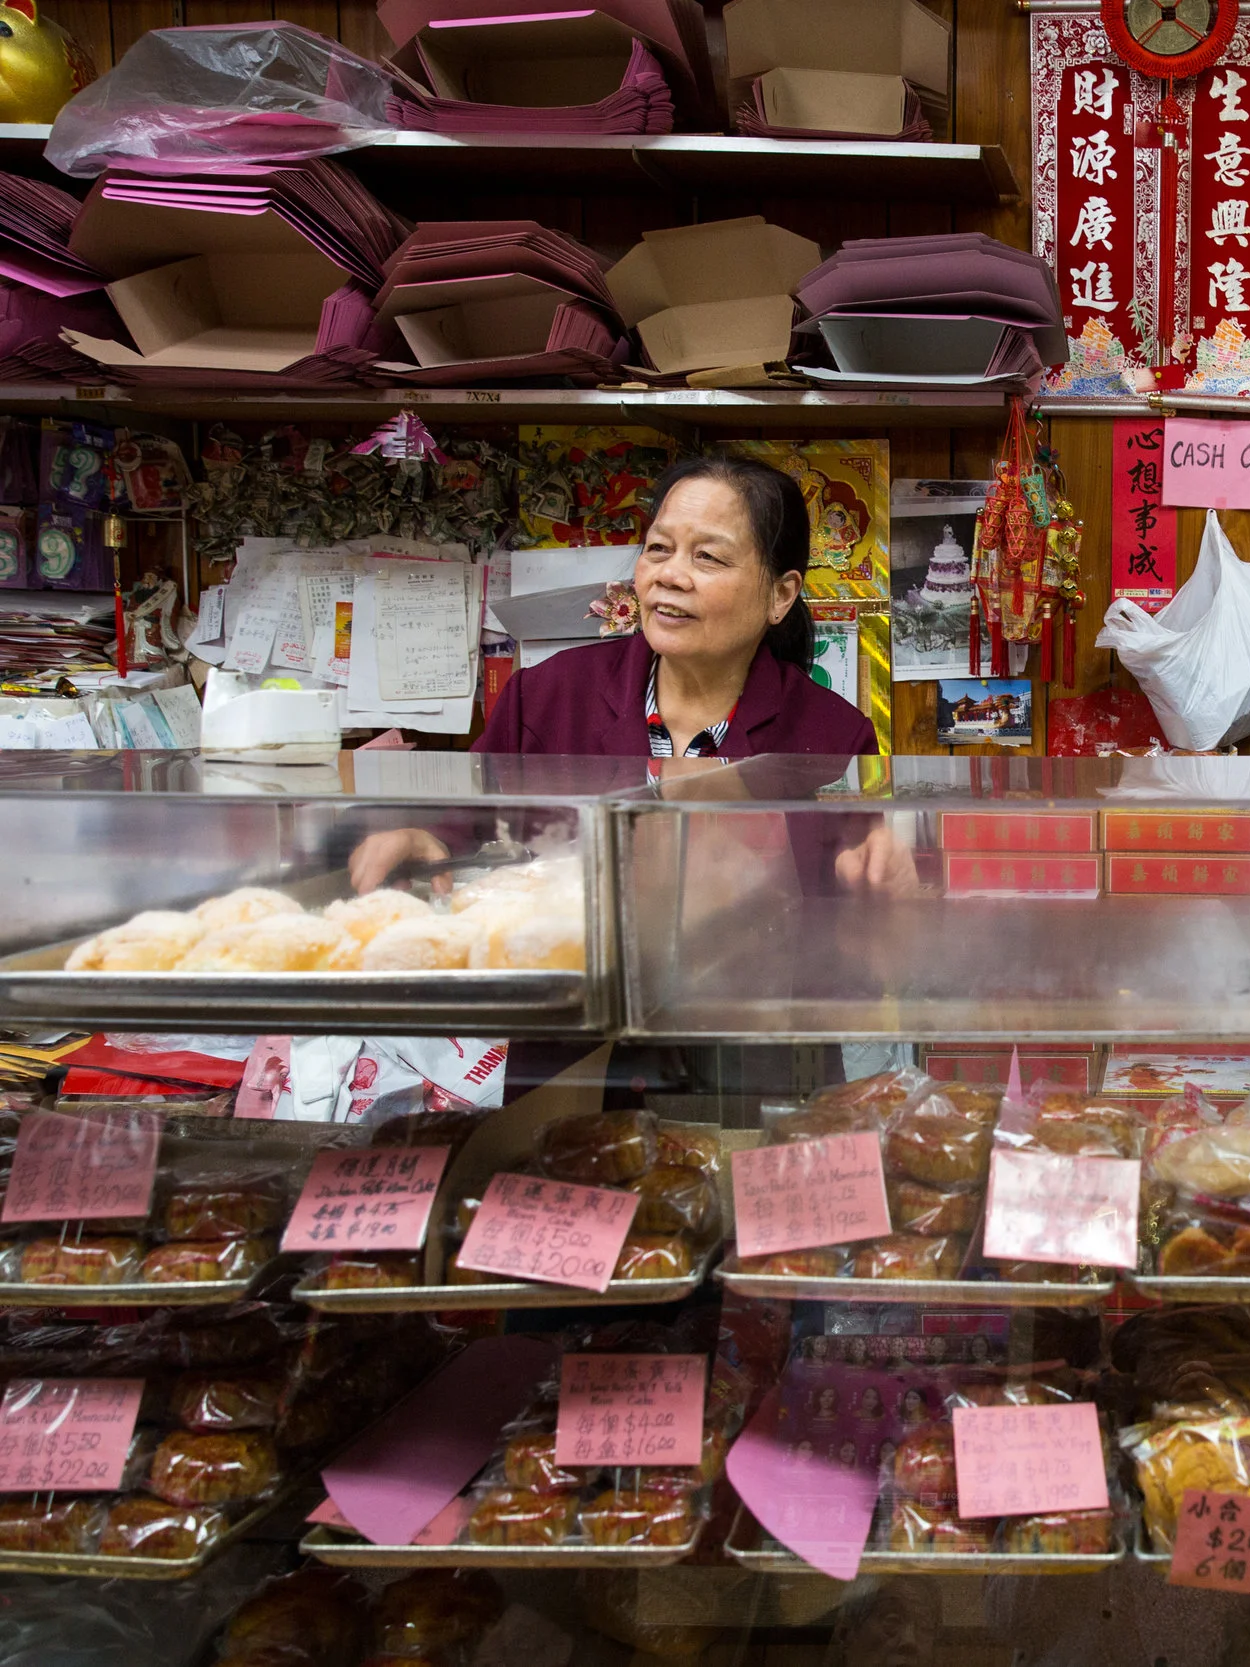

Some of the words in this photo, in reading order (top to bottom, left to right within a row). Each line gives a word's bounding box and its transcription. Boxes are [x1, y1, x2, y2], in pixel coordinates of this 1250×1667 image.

[1070, 69, 1119, 313] 財源廣進
[1170, 440, 1226, 469] CASH
